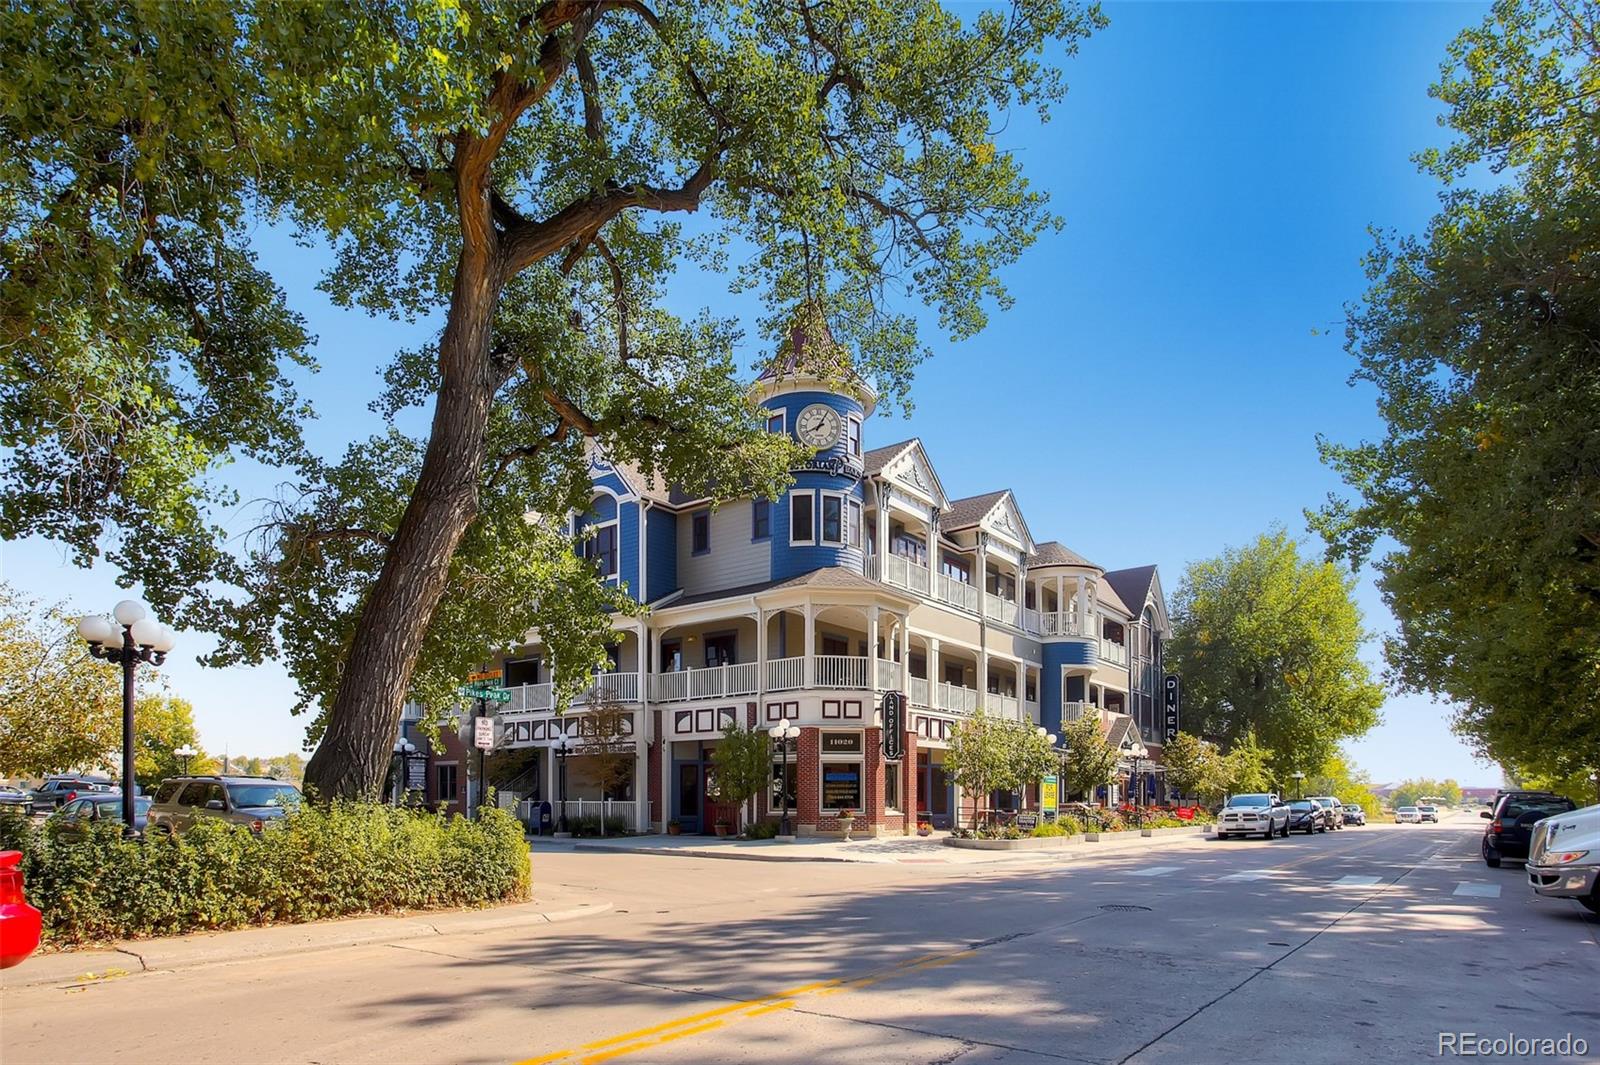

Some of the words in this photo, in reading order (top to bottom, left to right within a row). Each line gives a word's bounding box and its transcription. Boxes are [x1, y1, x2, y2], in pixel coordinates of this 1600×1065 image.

[466, 689, 483, 698] Pikes
[485, 690, 500, 700] Peak
[502, 691, 510, 701] Dr
[1166, 681, 1176, 737] DINER
[829, 738, 854, 746] 11020
